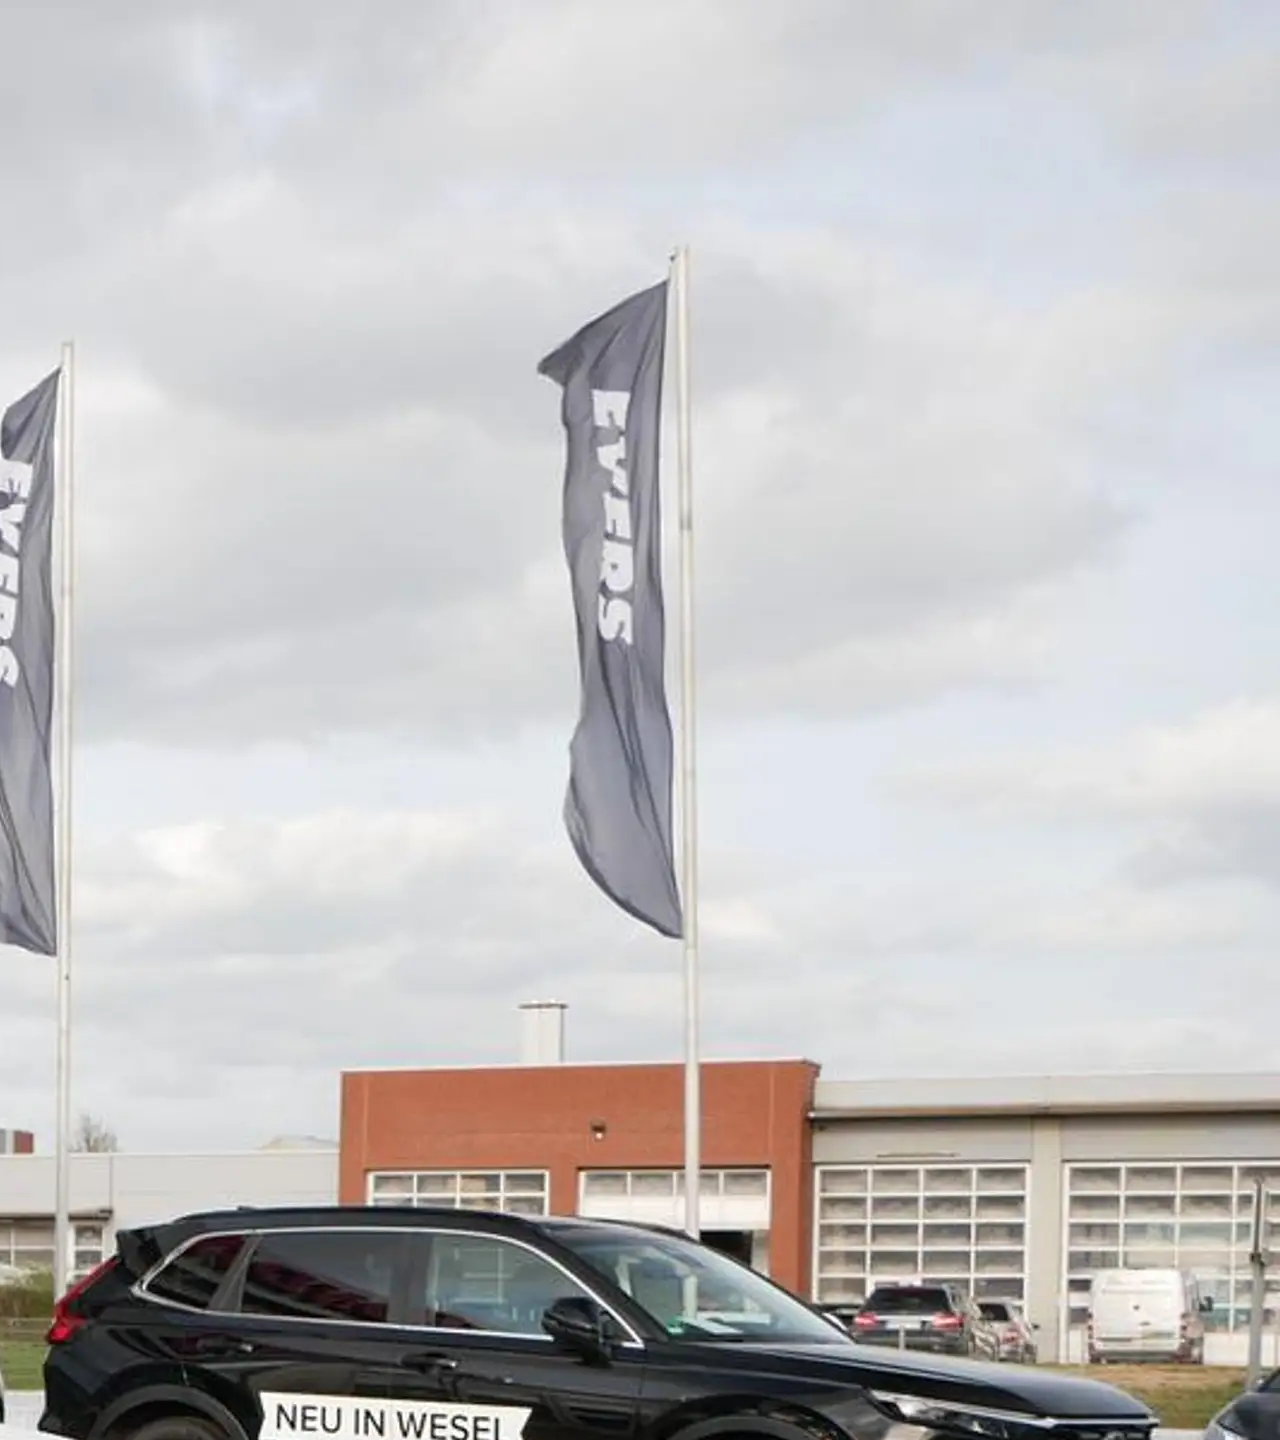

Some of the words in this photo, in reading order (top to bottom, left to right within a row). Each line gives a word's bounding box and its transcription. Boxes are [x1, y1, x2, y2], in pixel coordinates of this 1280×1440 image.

[590, 389, 634, 646] EVERS
[276, 1403, 341, 1434] NEU
[354, 1408, 385, 1437] IN
